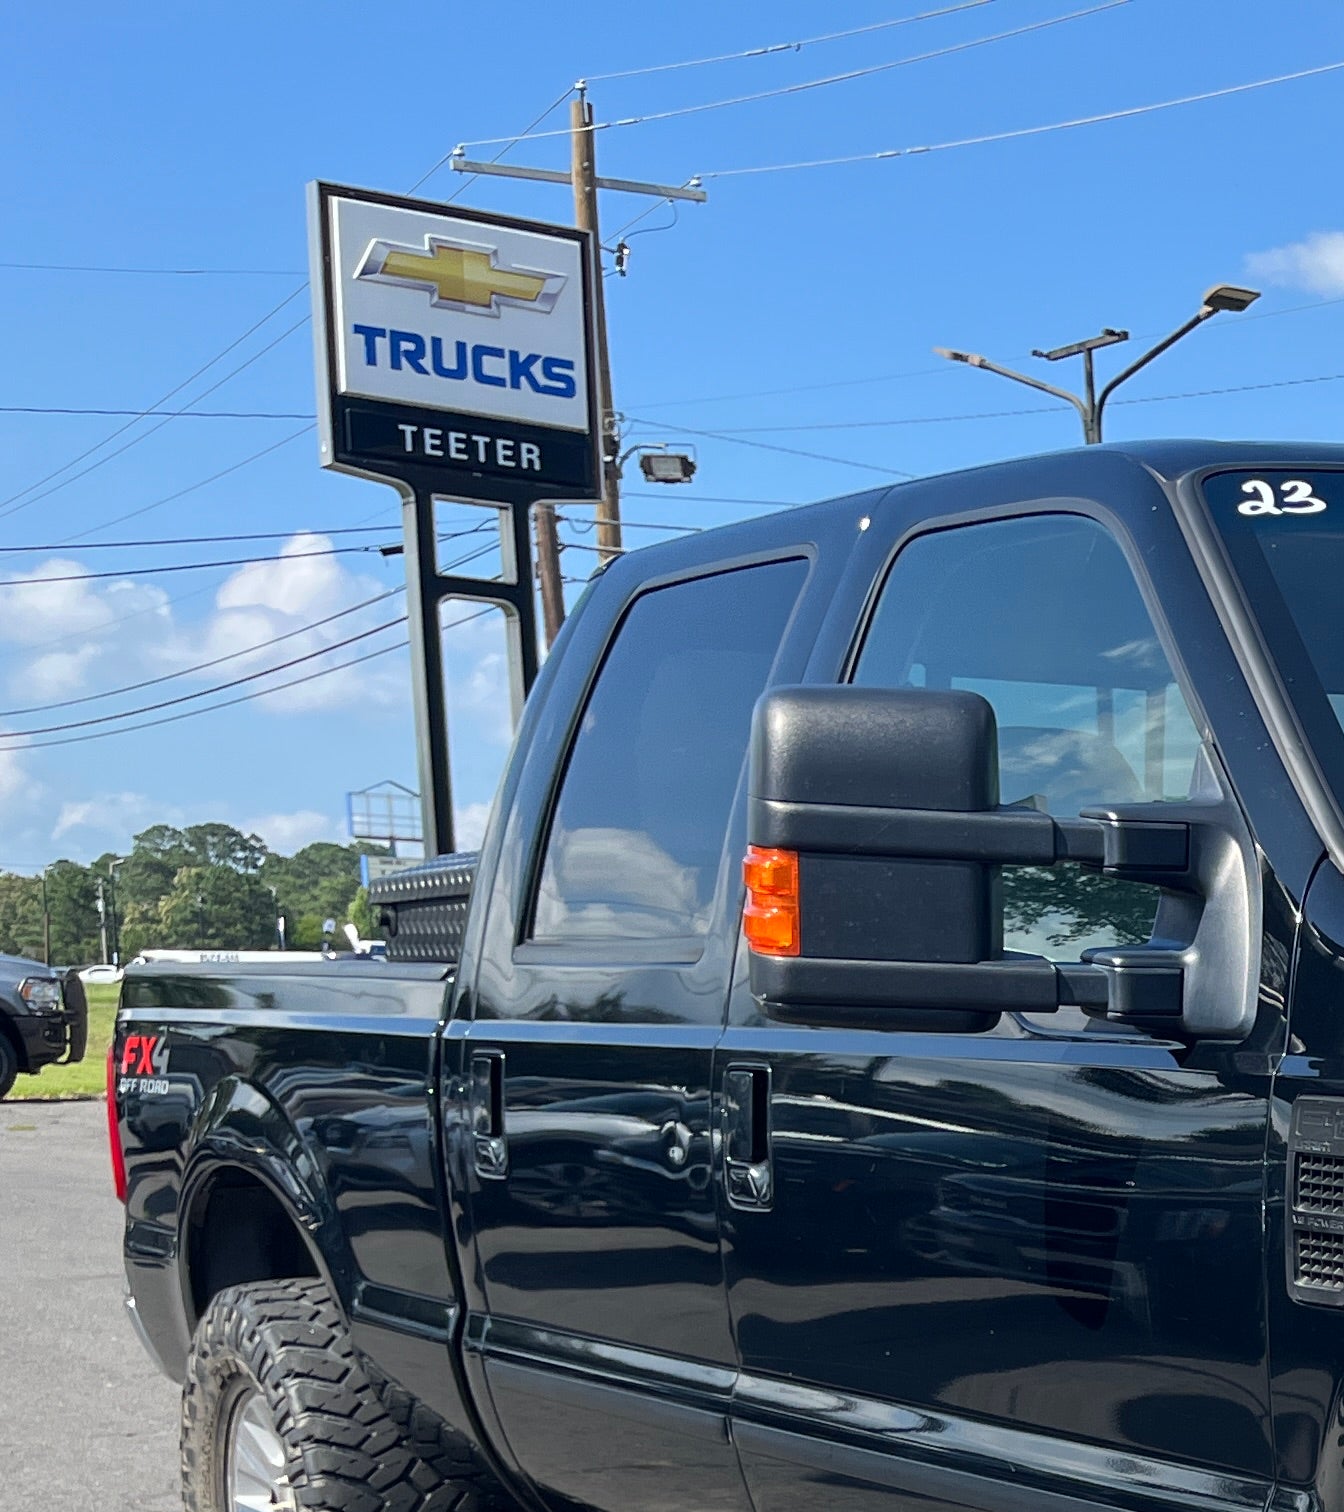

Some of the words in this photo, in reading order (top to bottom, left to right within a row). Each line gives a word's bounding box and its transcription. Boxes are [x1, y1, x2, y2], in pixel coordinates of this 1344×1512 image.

[353, 323, 577, 399] TRUCKS
[397, 423, 543, 472] TEETER
[1237, 480, 1327, 515] 23
[121, 1034, 170, 1076] FX4
[119, 1077, 138, 1093] OFF
[139, 1078, 170, 1095] ROAD
